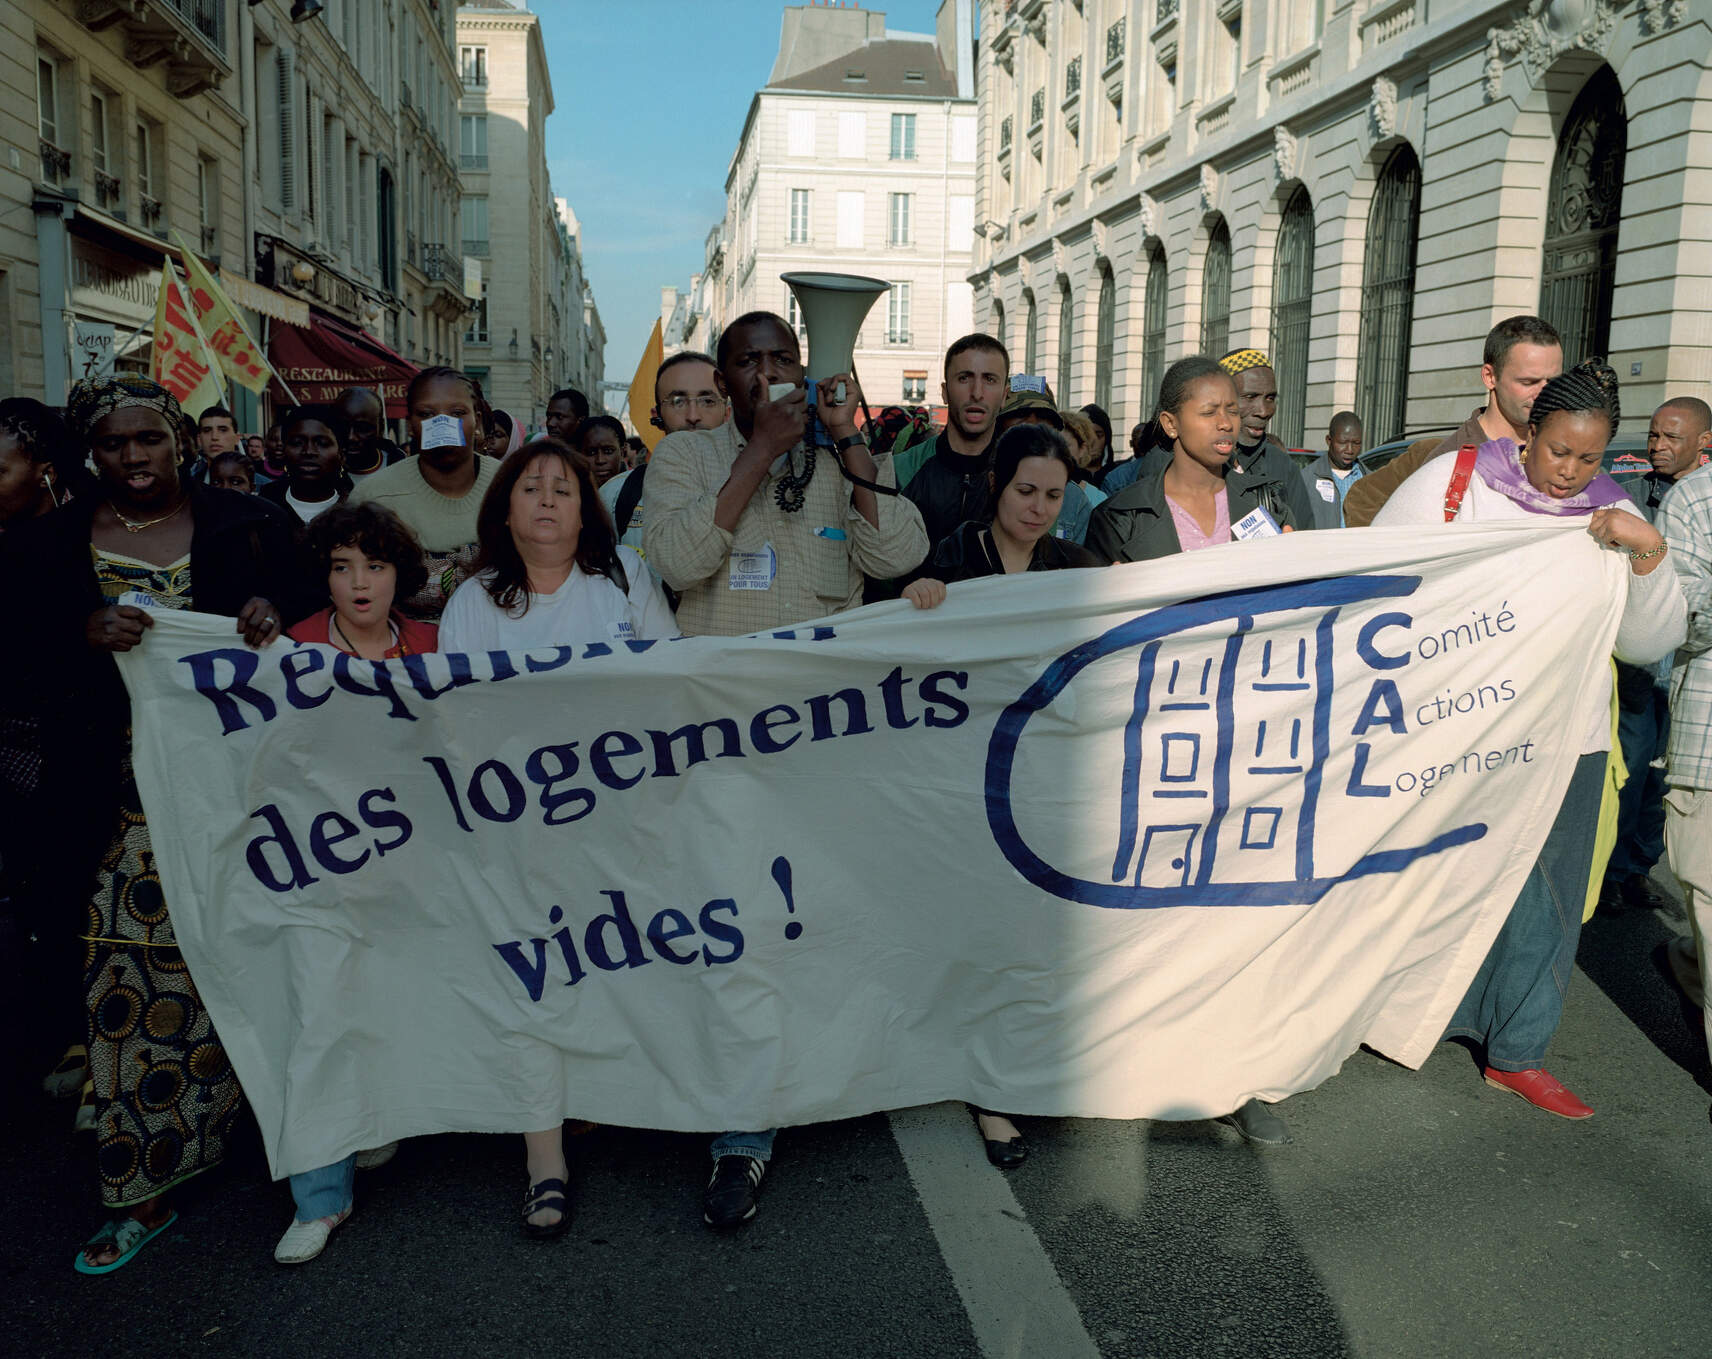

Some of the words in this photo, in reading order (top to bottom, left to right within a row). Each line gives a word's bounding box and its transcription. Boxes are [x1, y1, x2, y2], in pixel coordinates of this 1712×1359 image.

[1240, 515, 1257, 530] NON
[245, 786, 413, 893] des
[422, 666, 970, 832] logements
[492, 890, 745, 1002] vides
[771, 856, 803, 940] !
